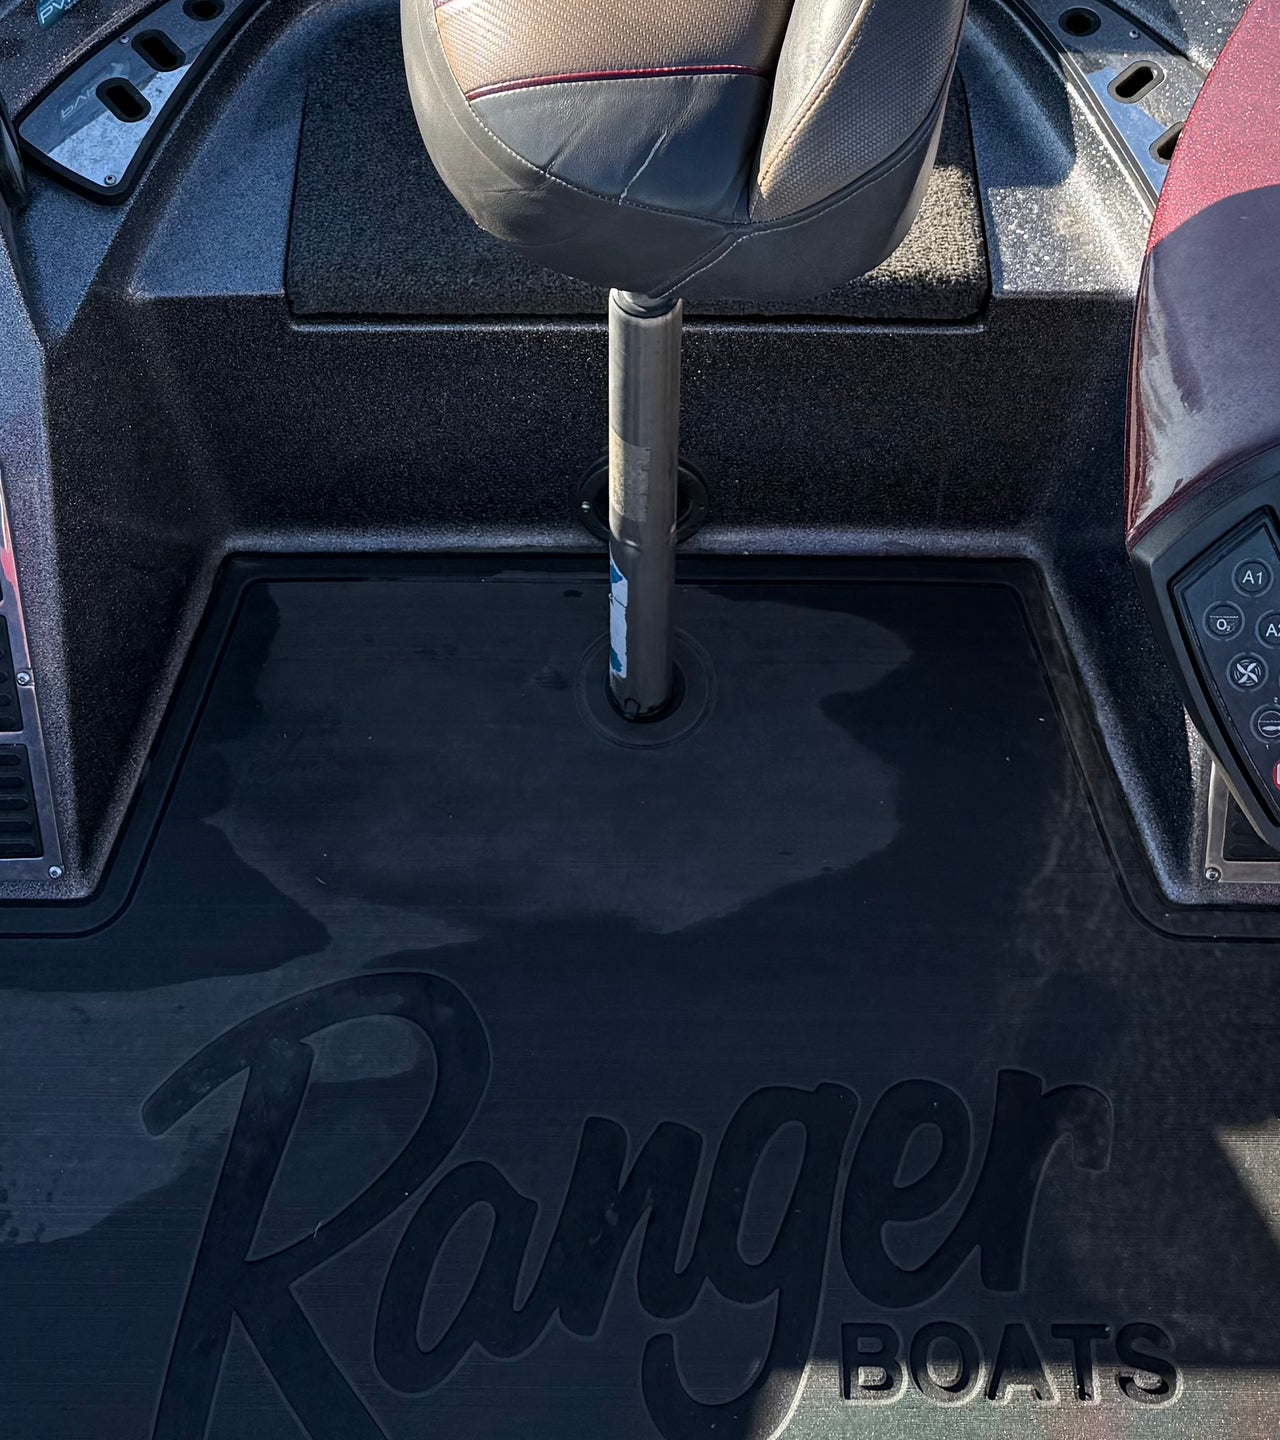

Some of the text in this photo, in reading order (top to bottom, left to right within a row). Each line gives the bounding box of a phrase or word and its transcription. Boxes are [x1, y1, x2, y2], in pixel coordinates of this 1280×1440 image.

[1242, 570, 1263, 585] A1
[140, 970, 1116, 1440] Ranger
[837, 1322, 1183, 1409] BOATS
